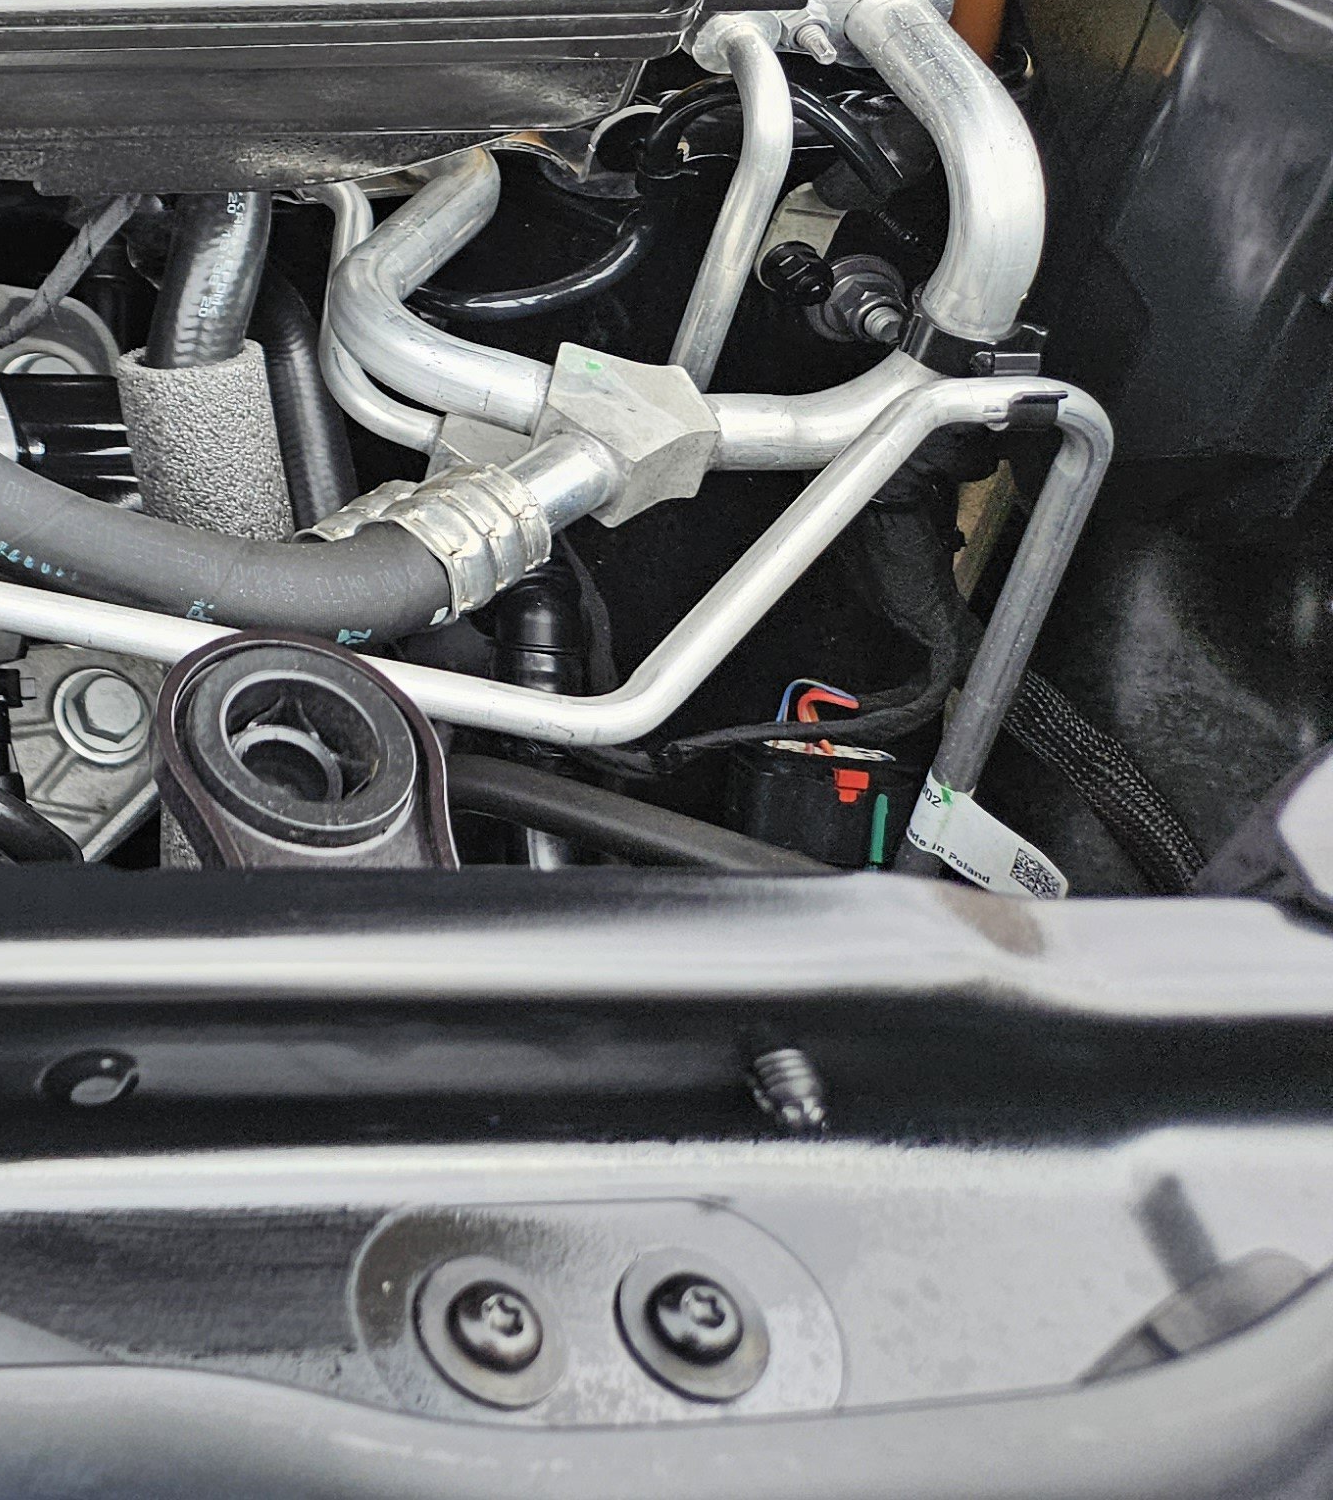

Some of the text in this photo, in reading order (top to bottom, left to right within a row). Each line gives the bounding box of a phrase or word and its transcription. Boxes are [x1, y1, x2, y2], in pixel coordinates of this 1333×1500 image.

[908, 828, 991, 884] ade in Poland
